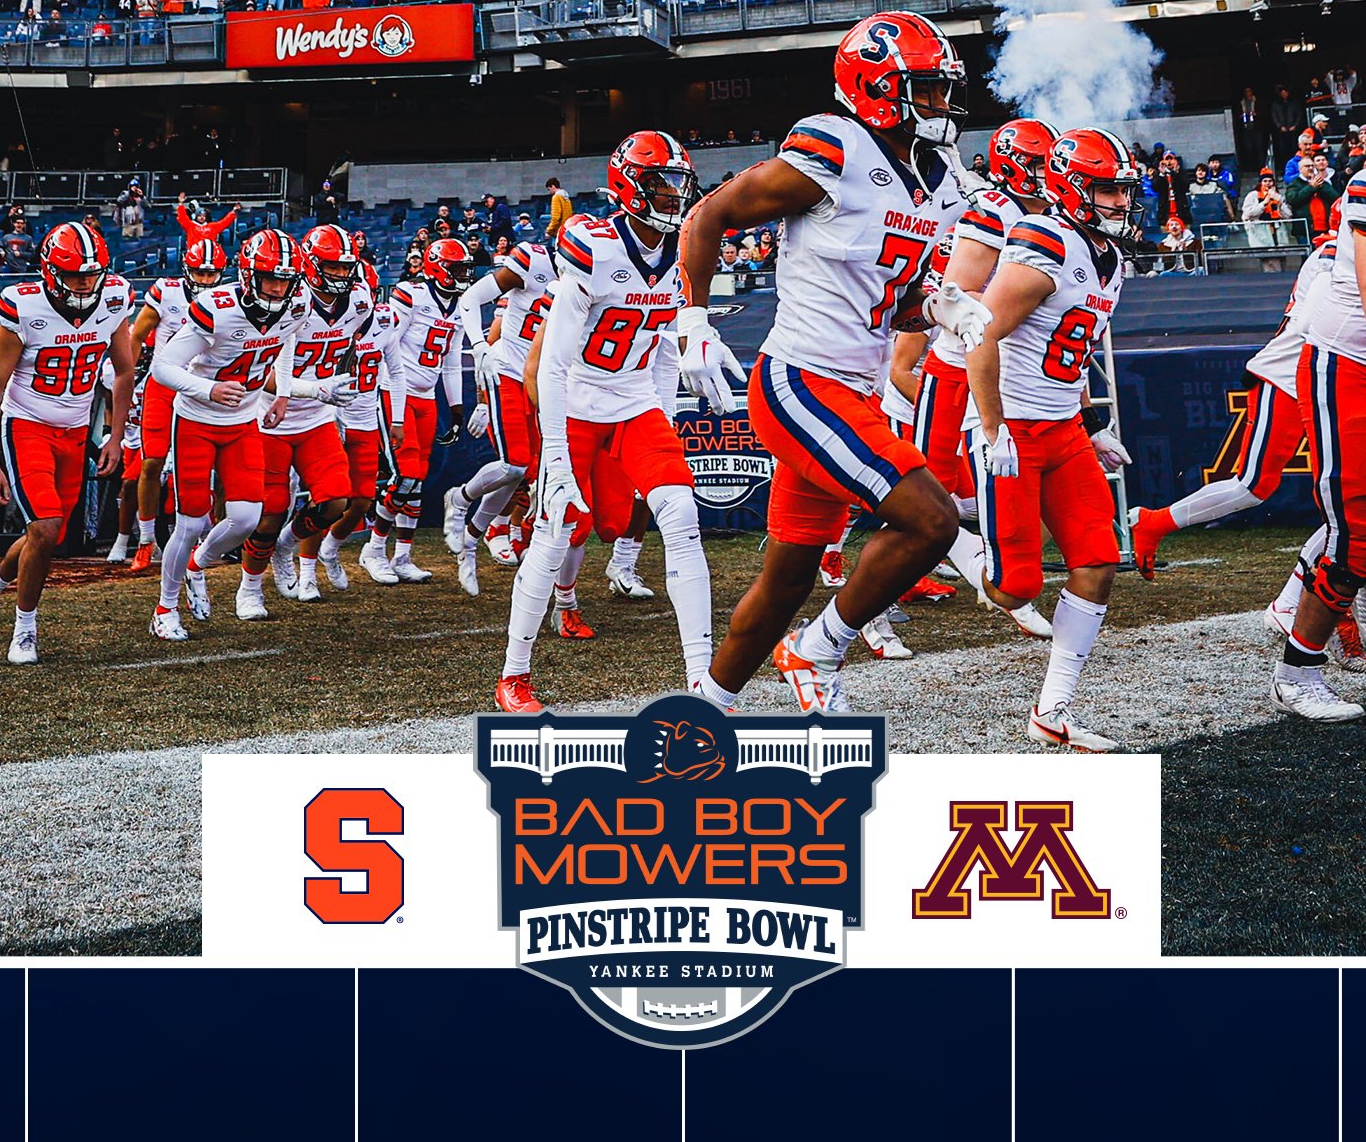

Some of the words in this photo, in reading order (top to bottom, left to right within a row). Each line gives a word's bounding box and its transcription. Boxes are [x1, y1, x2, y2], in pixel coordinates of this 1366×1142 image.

[276, 18, 369, 61] Wendy's
[859, 21, 901, 63] S
[984, 191, 1010, 208] 81
[585, 220, 619, 240] 87
[884, 210, 939, 237] ORANGE
[869, 232, 928, 330] 7
[625, 293, 672, 305] ORANGE
[1085, 293, 1114, 313] ORANGE
[55, 332, 98, 345] ORANGE
[243, 336, 281, 350] ORANGE
[312, 329, 344, 340] ORANGE
[582, 307, 678, 373] 87
[355, 342, 375, 352] ANGE
[418, 327, 456, 368] 51
[292, 337, 351, 379] 75
[31, 341, 108, 397] 98
[720, 420, 753, 435] BO
[682, 436, 767, 452] OWERS
[734, 459, 768, 474] BOWL
